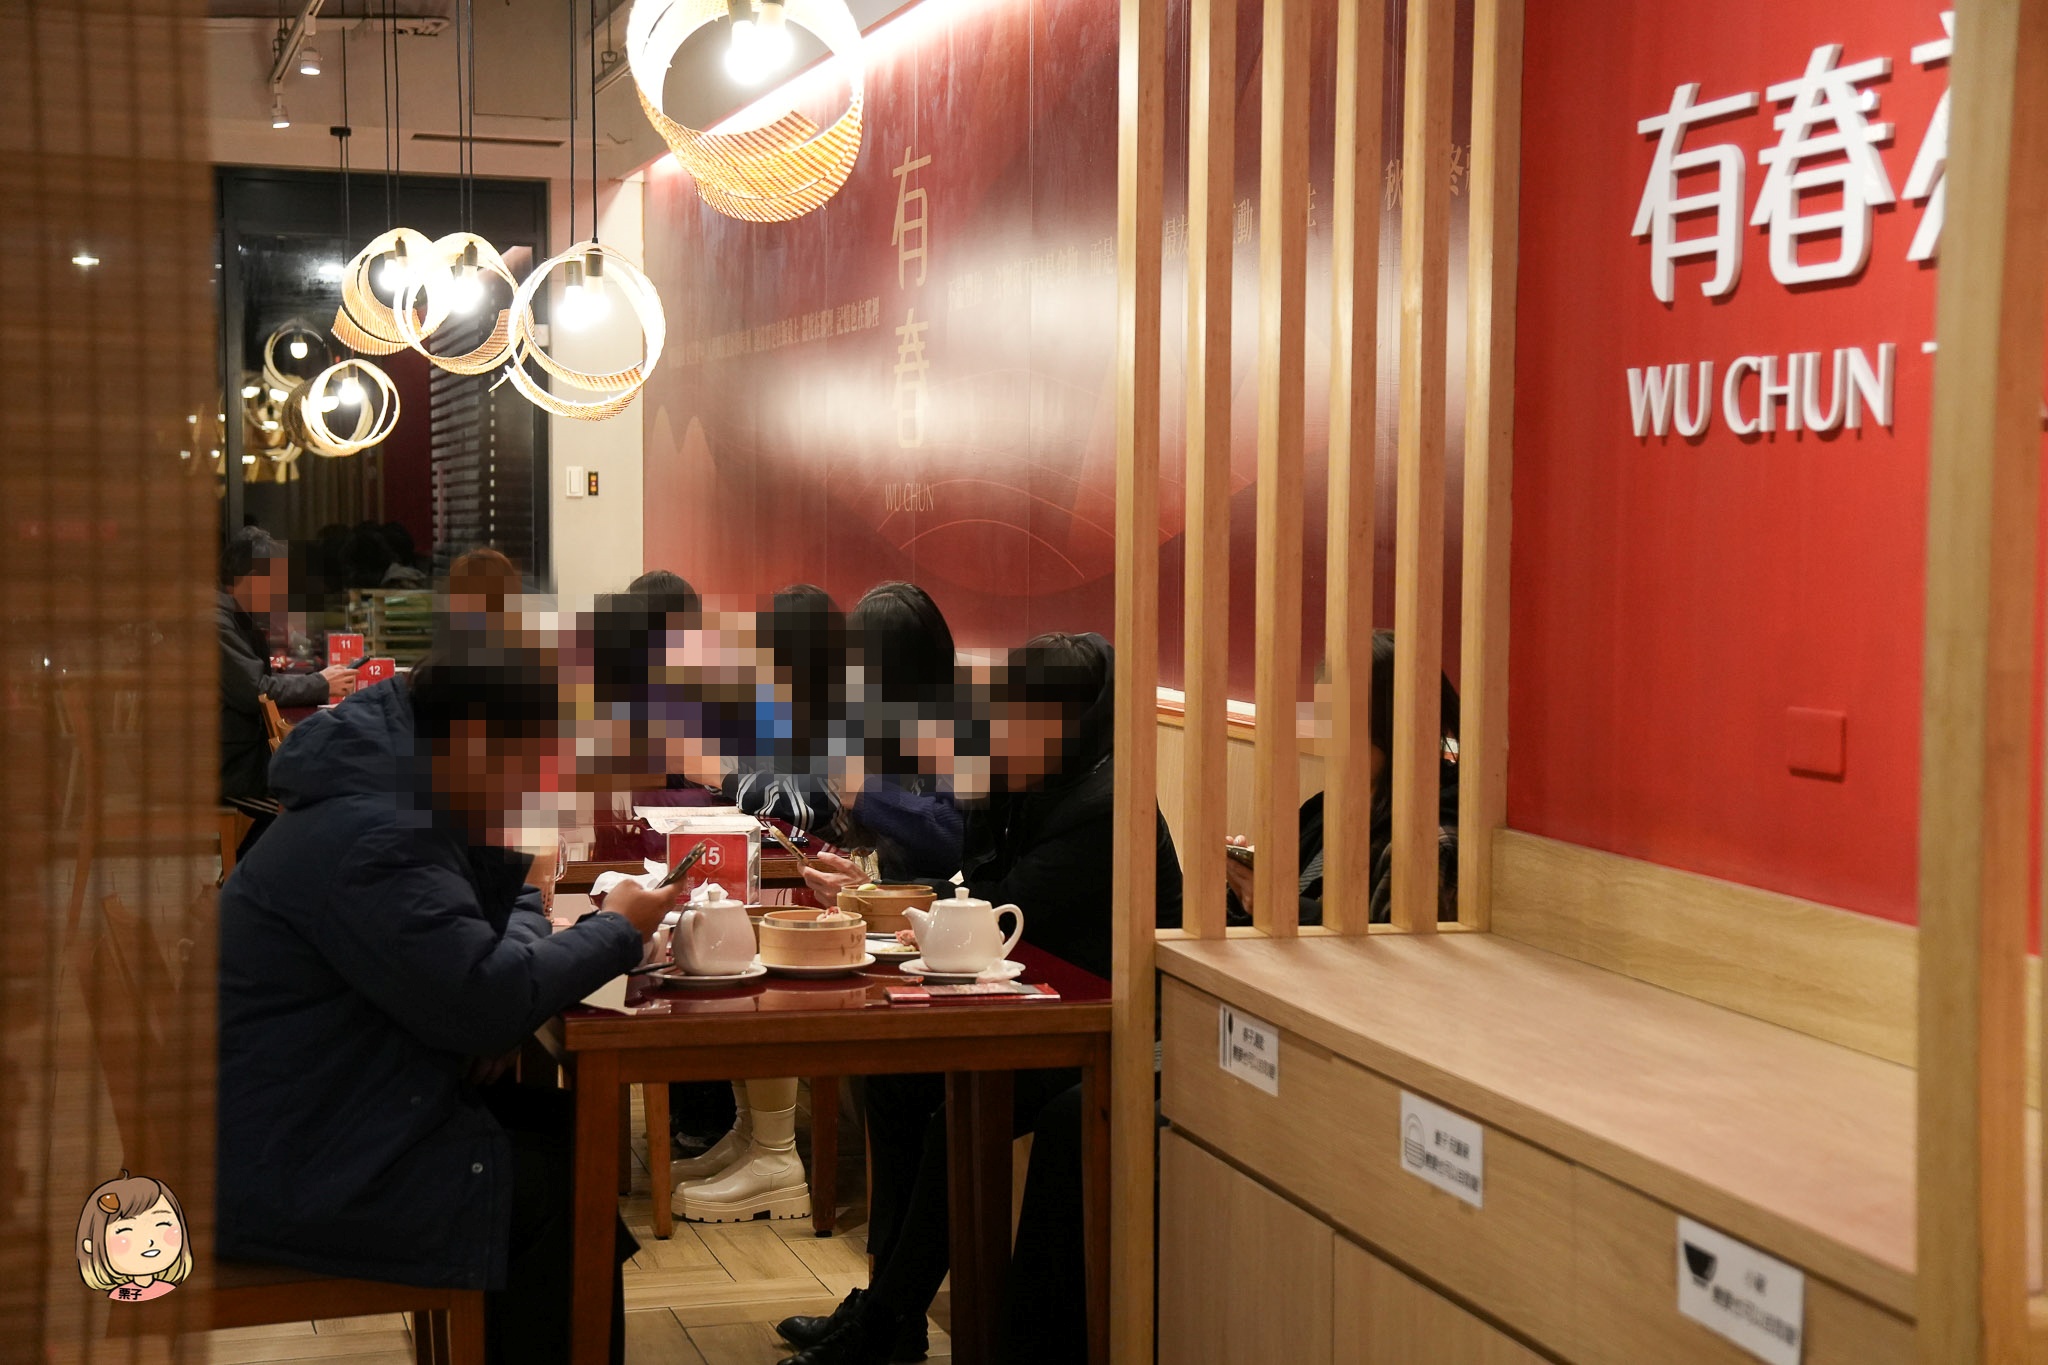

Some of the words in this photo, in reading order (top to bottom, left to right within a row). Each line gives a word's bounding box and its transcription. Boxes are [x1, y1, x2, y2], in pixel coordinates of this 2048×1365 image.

[890, 145, 932, 449] 有春
[1627, 360, 1714, 438] WU
[1722, 342, 1897, 436] CHUN
[885, 482, 902, 512] WU
[903, 481, 935, 512] CHUN
[341, 639, 351, 649] 11
[369, 665, 381, 676] 12
[701, 846, 720, 866] 15
